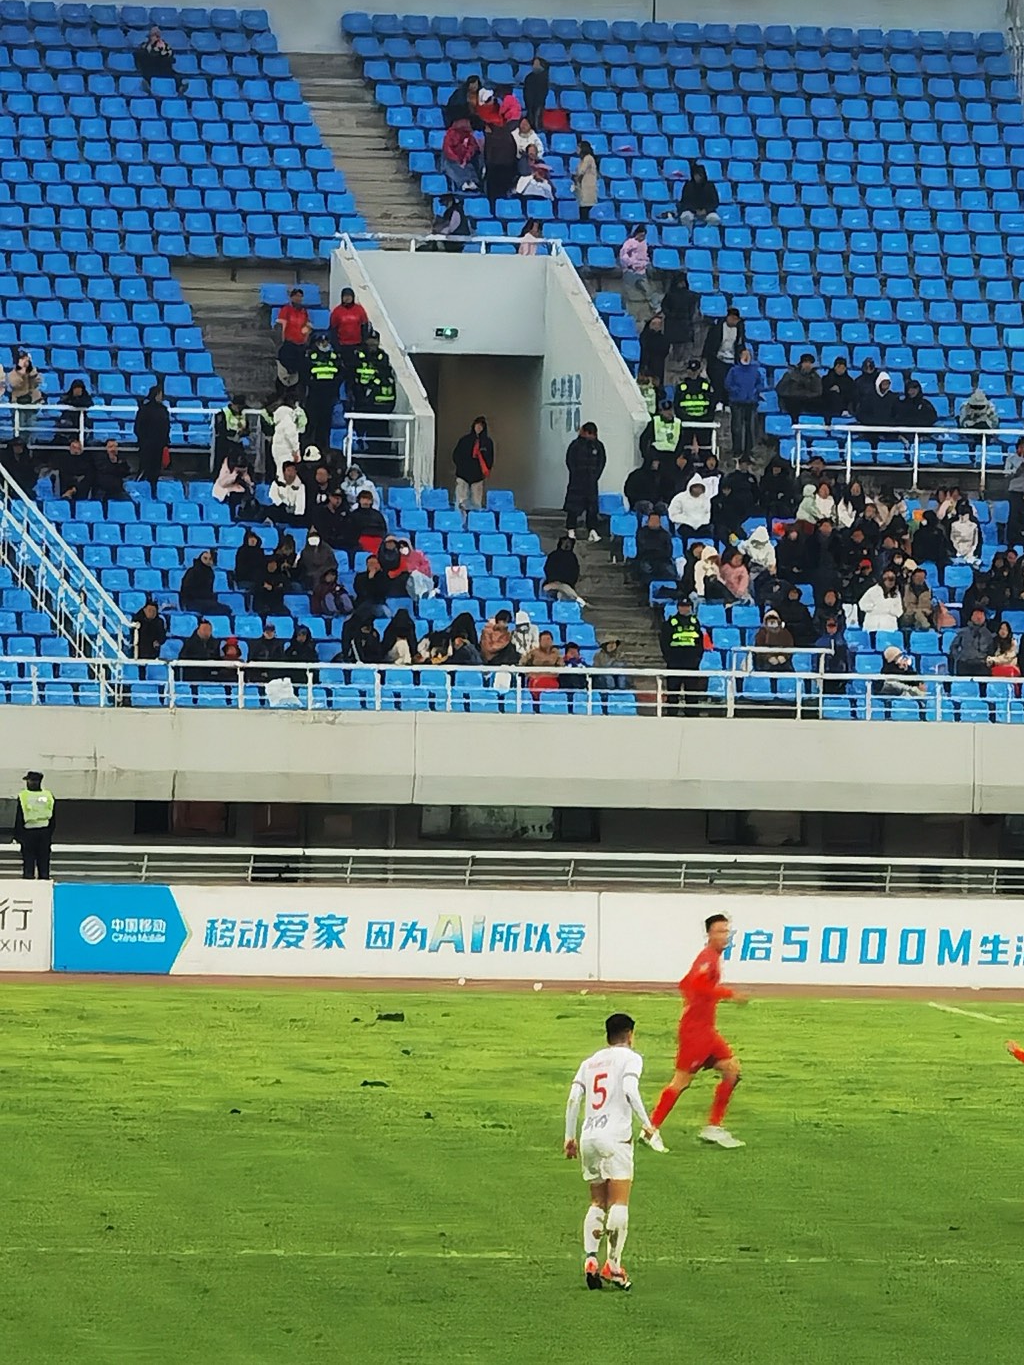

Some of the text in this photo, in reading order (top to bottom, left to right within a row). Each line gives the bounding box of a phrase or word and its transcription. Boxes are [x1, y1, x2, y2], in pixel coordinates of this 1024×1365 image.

[111, 917, 167, 933] 中国移动
[204, 913, 350, 949] 移动爱家
[592, 1072, 608, 1111] 5
